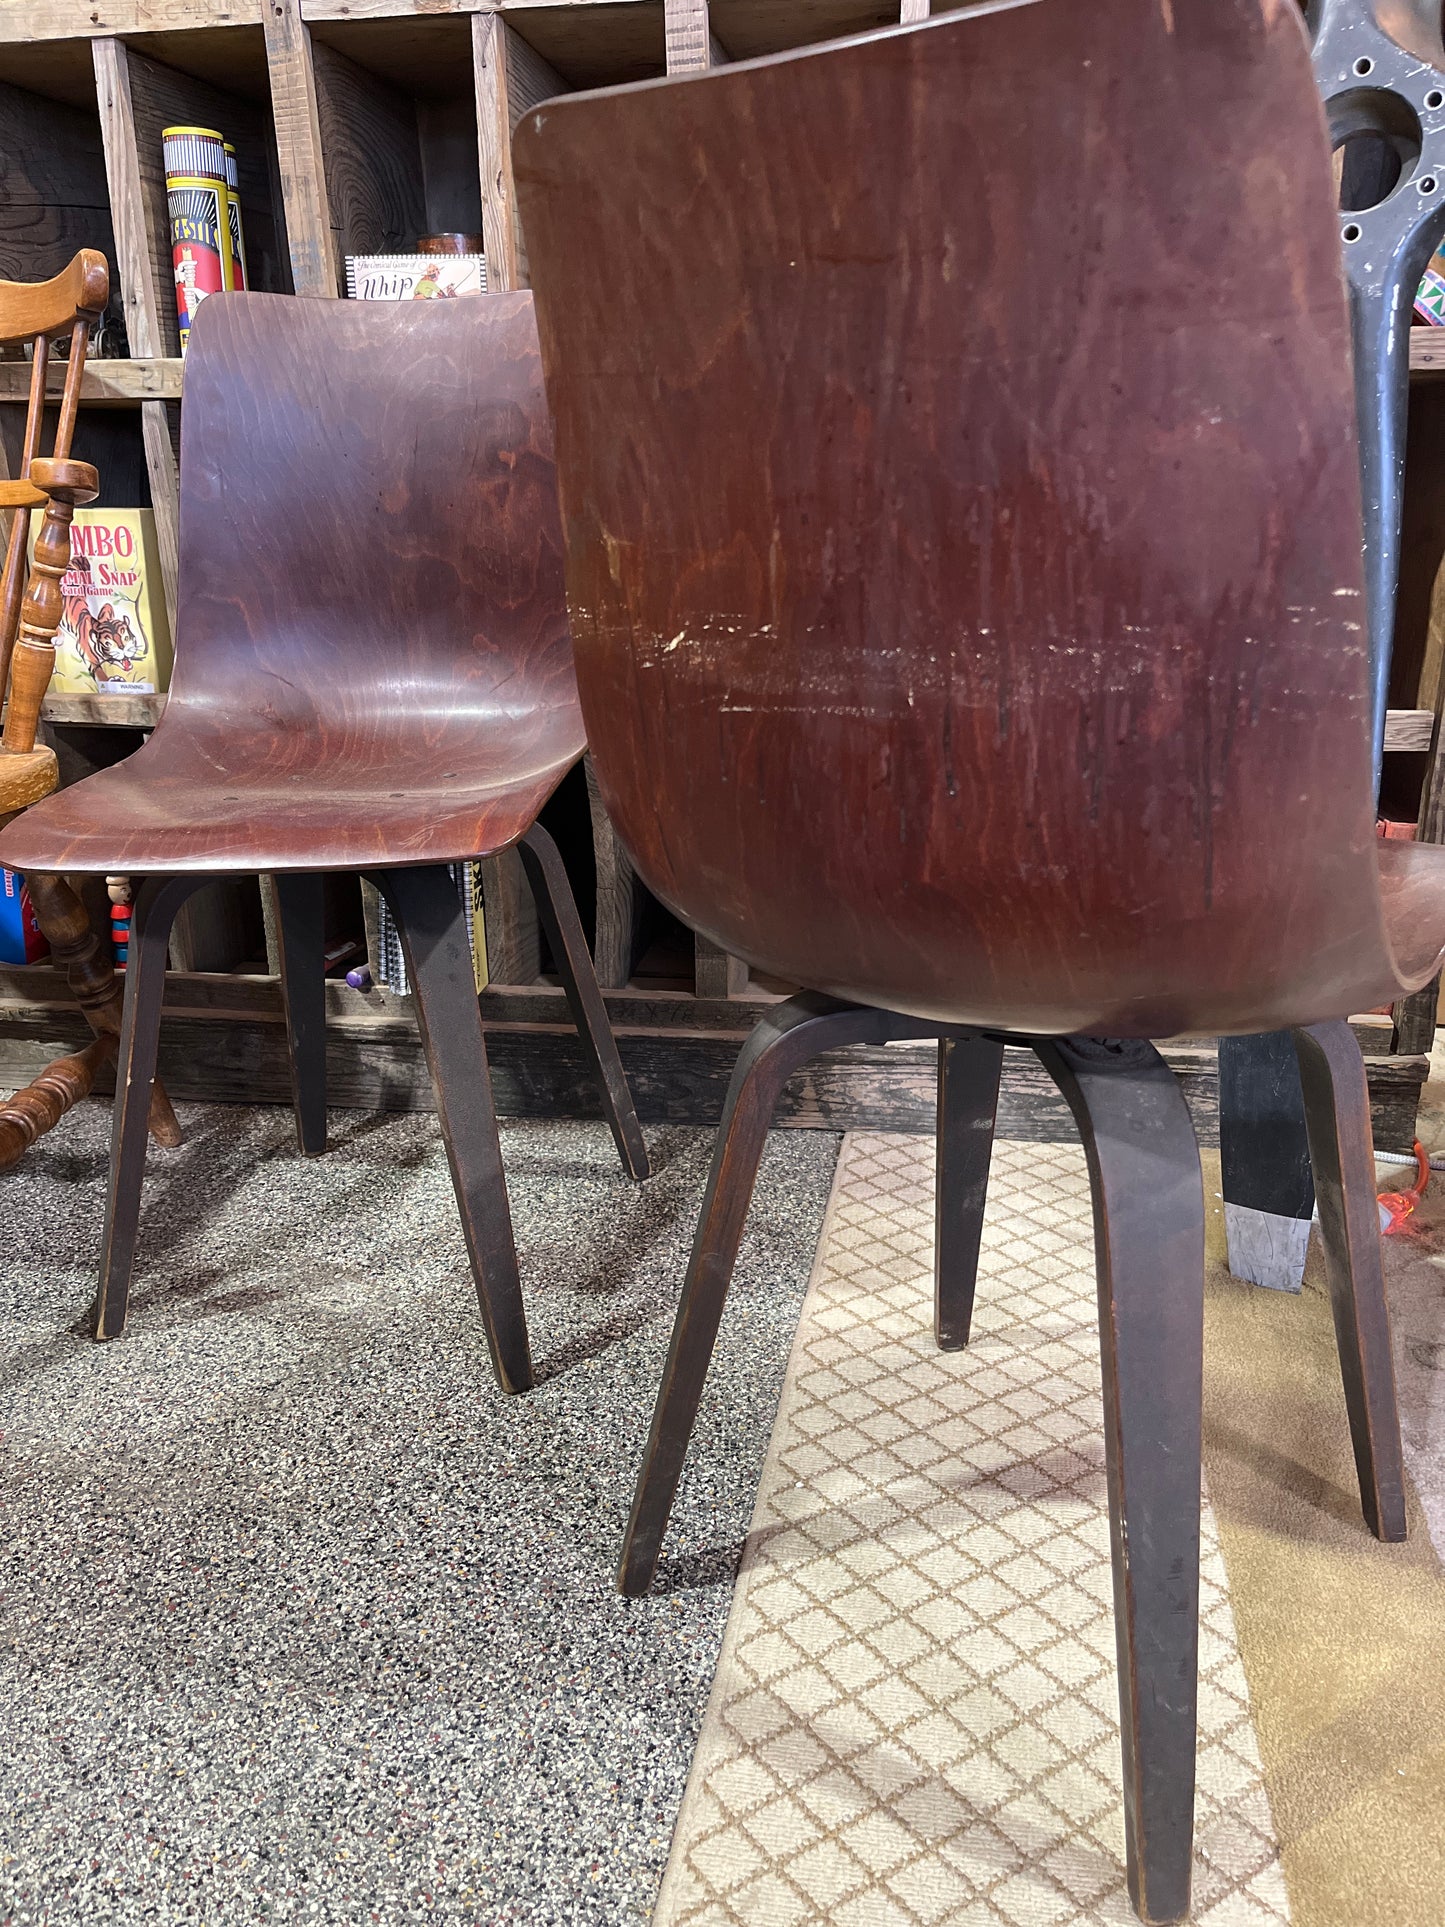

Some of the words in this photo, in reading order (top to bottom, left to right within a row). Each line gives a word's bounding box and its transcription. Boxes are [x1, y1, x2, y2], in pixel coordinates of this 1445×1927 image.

[357, 260, 369, 271] The
[393, 260, 409, 269] Game
[364, 275, 413, 300] Whip
[69, 525, 133, 557] MBO
[61, 571, 94, 585] IMAL
[98, 563, 138, 586] SNAP
[61, 586, 84, 596] Card
[87, 587, 114, 596] Game
